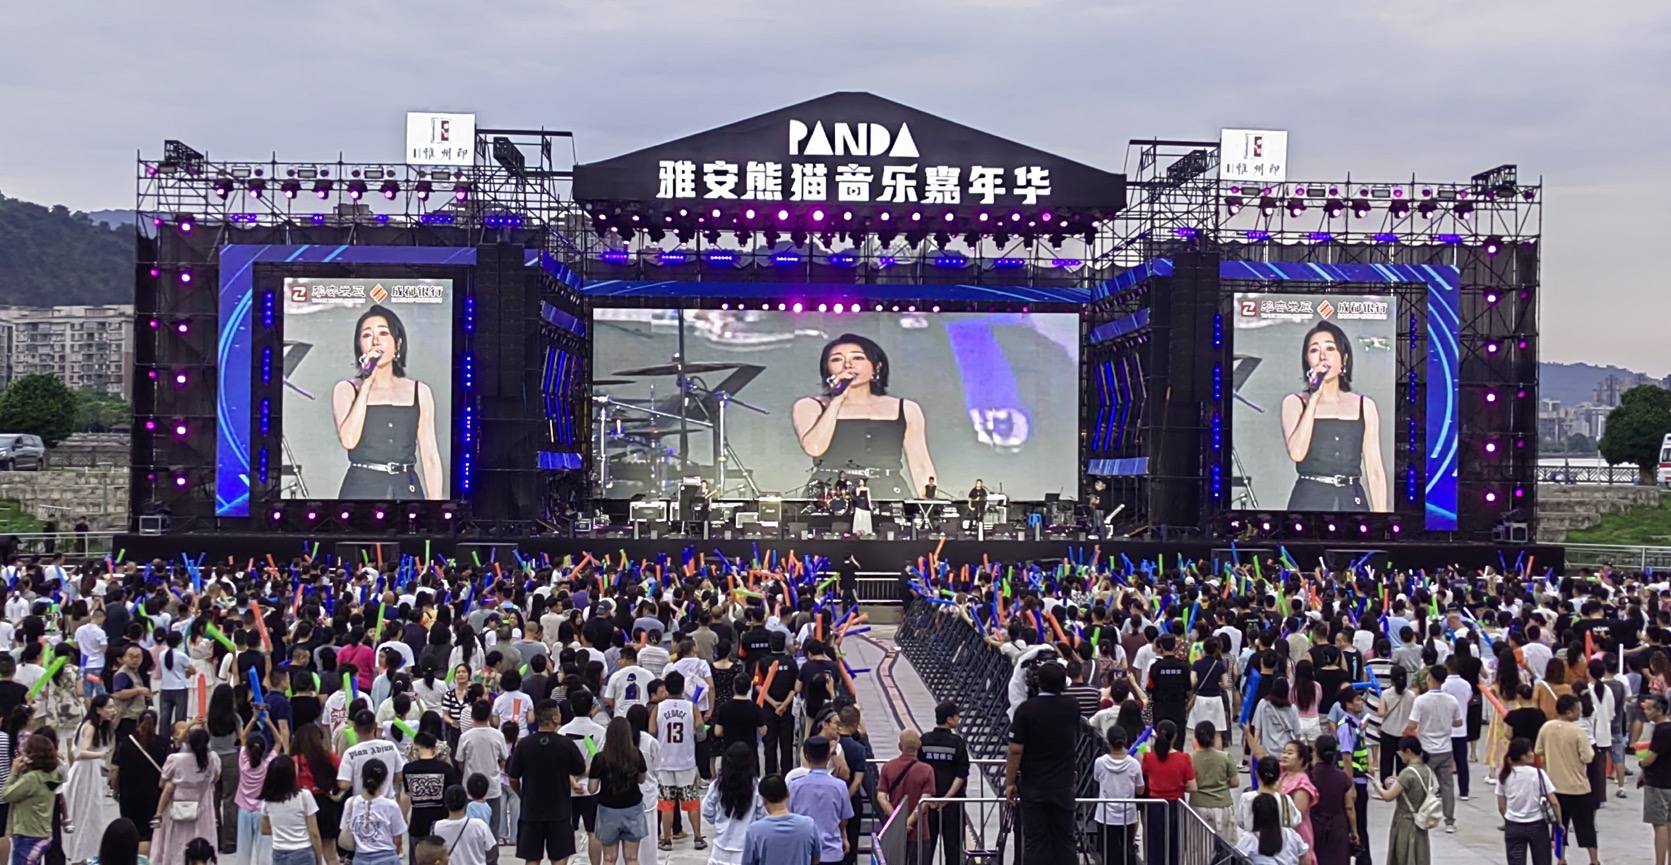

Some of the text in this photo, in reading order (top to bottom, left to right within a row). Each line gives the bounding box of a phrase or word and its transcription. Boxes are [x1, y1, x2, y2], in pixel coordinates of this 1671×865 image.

[789, 119, 920, 157] PANDA
[656, 160, 1052, 204] 雅安熊猫音乐嘉年华
[663, 709, 687, 720] GEORGE
[667, 722, 684, 743] 13
